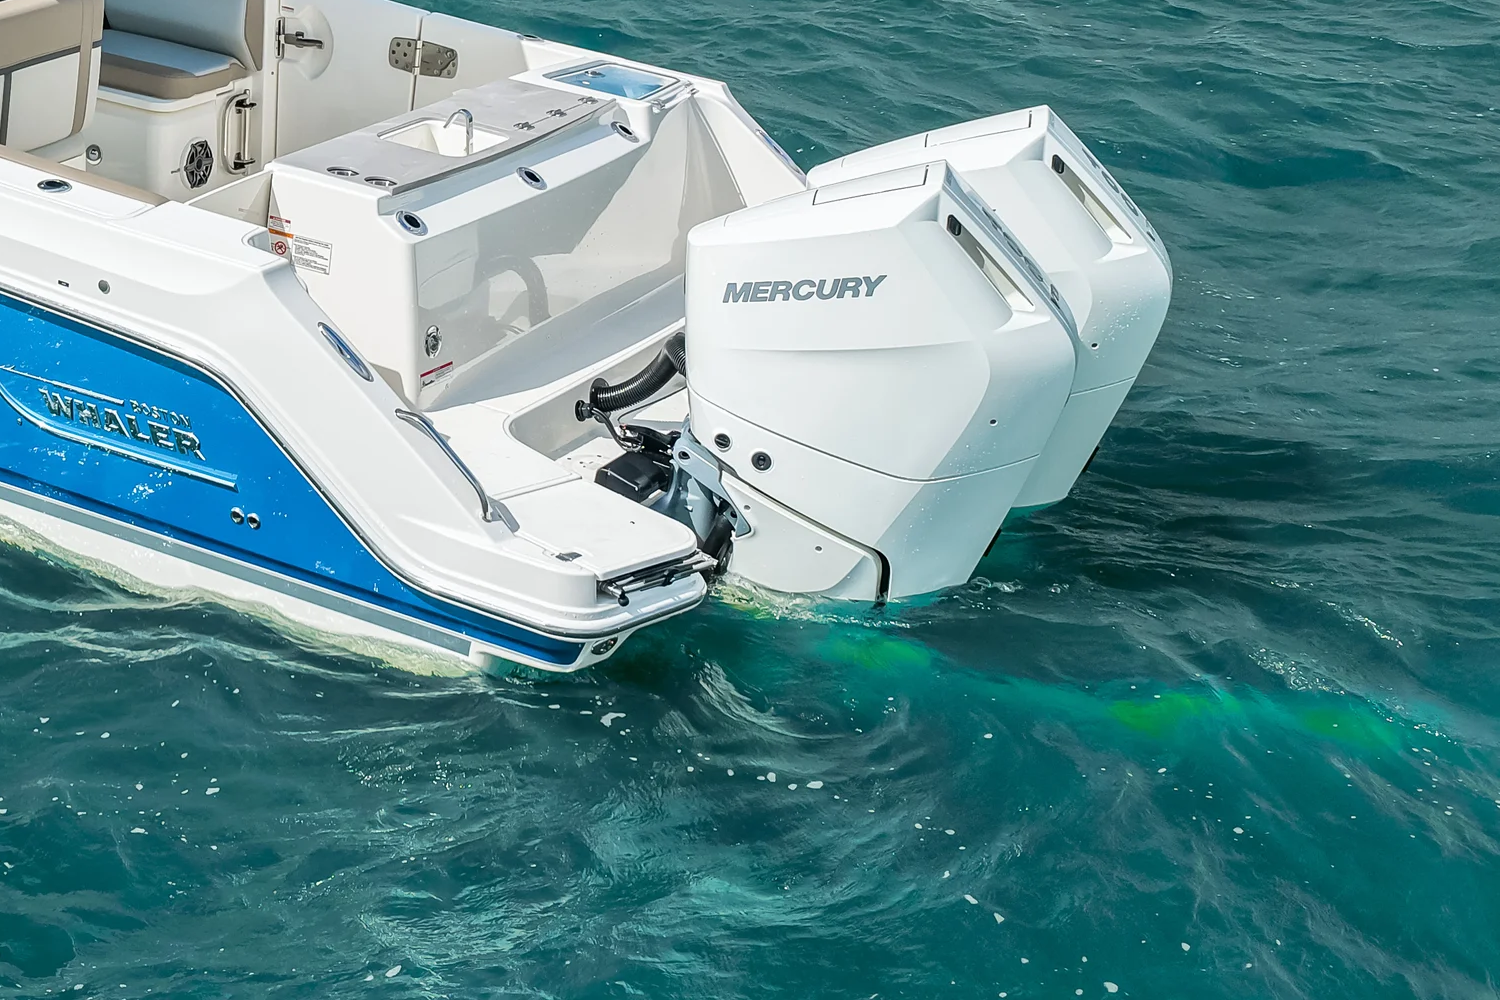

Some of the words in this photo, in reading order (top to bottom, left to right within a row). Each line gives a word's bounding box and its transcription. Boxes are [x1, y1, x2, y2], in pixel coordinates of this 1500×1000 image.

[722, 274, 888, 304] MERCURY
[38, 387, 207, 462] WHALER
[128, 398, 193, 430] BOSTON
